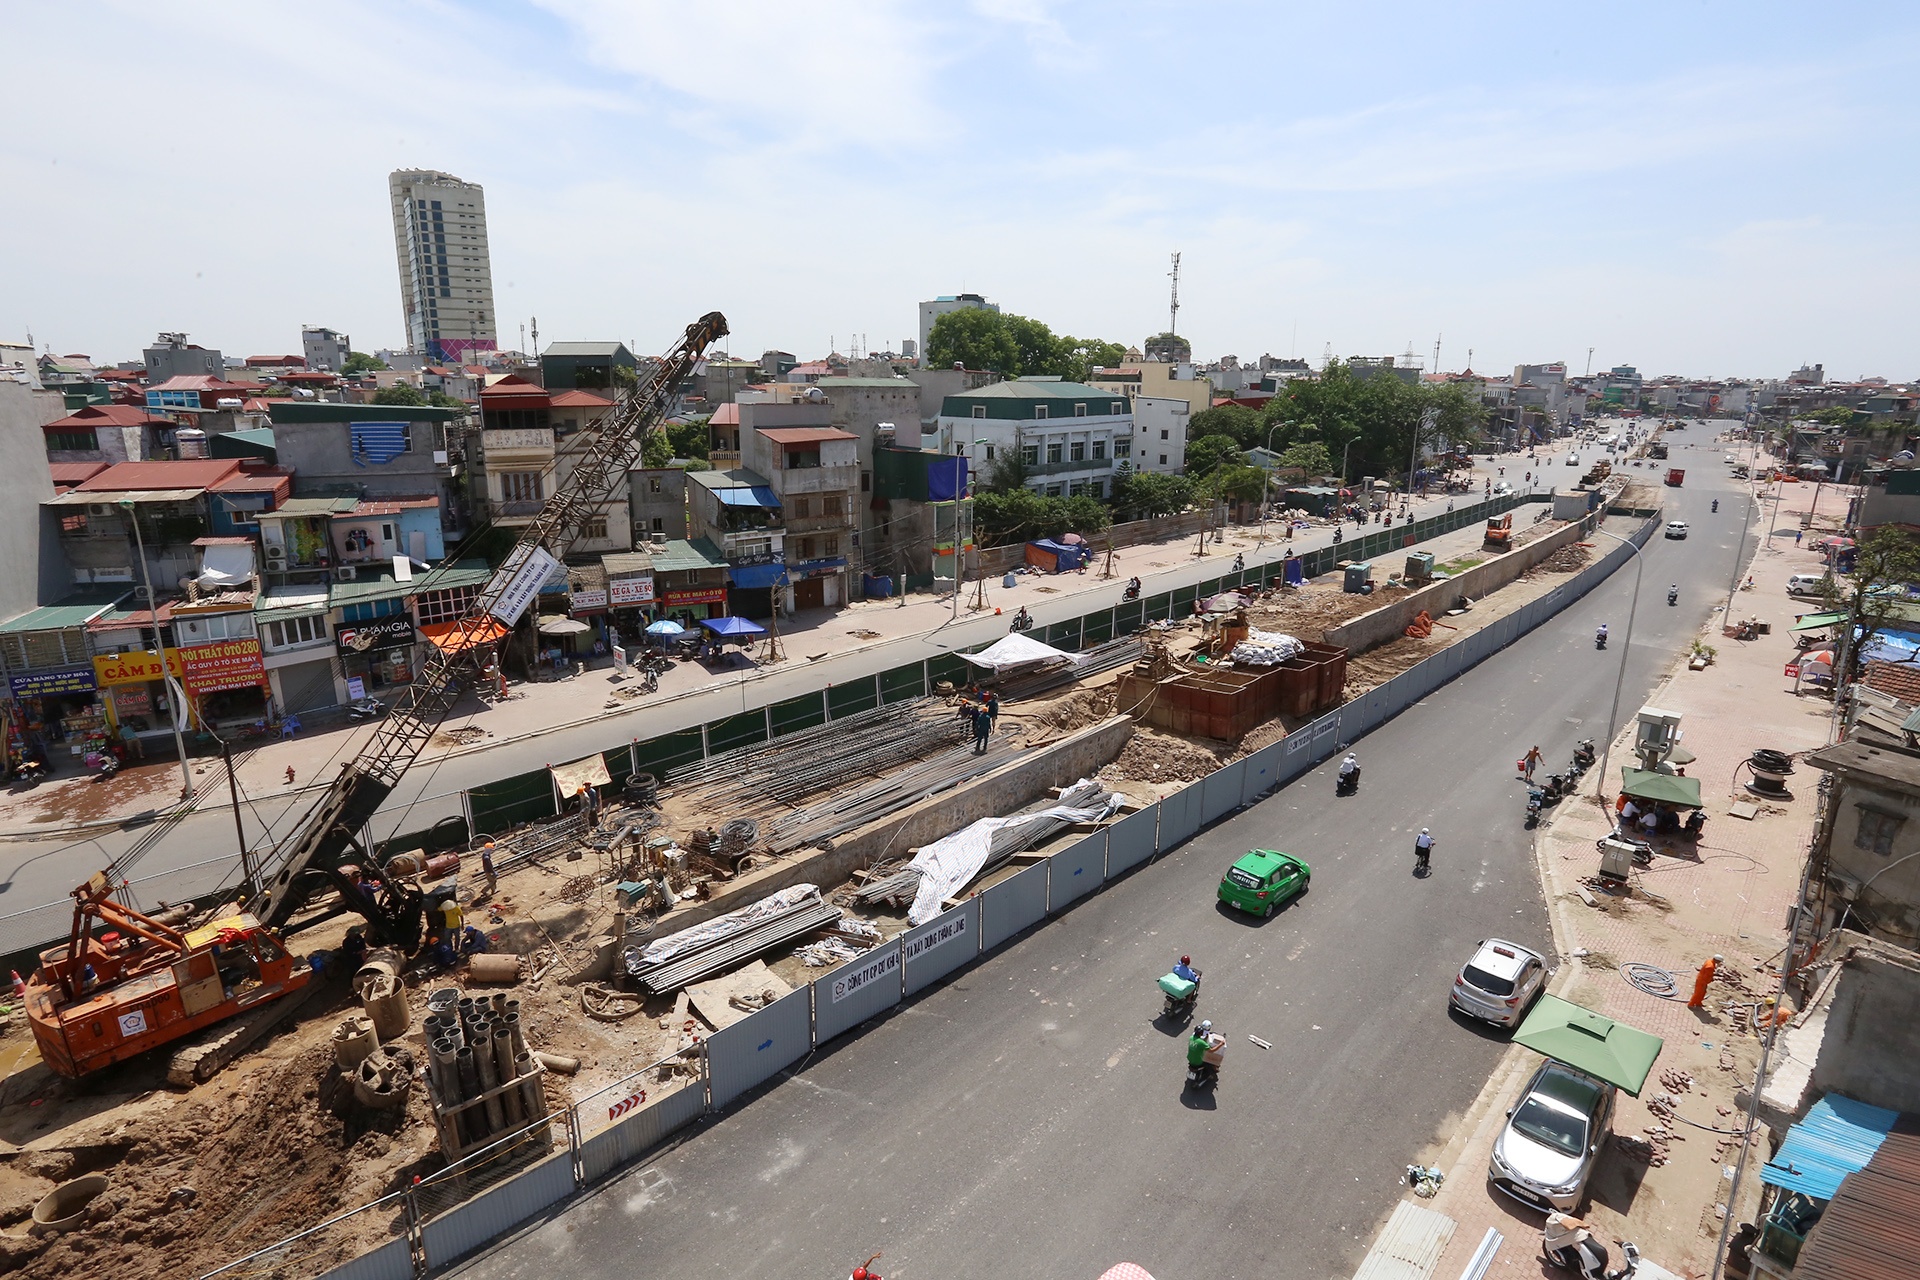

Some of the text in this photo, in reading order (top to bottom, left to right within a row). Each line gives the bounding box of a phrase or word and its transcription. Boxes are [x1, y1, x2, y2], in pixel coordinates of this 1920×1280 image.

[198, 645, 222, 659] THẤT
[241, 641, 259, 654] 280
[104, 662, 145, 679] CẦM
[190, 680, 216, 688] KHAI
